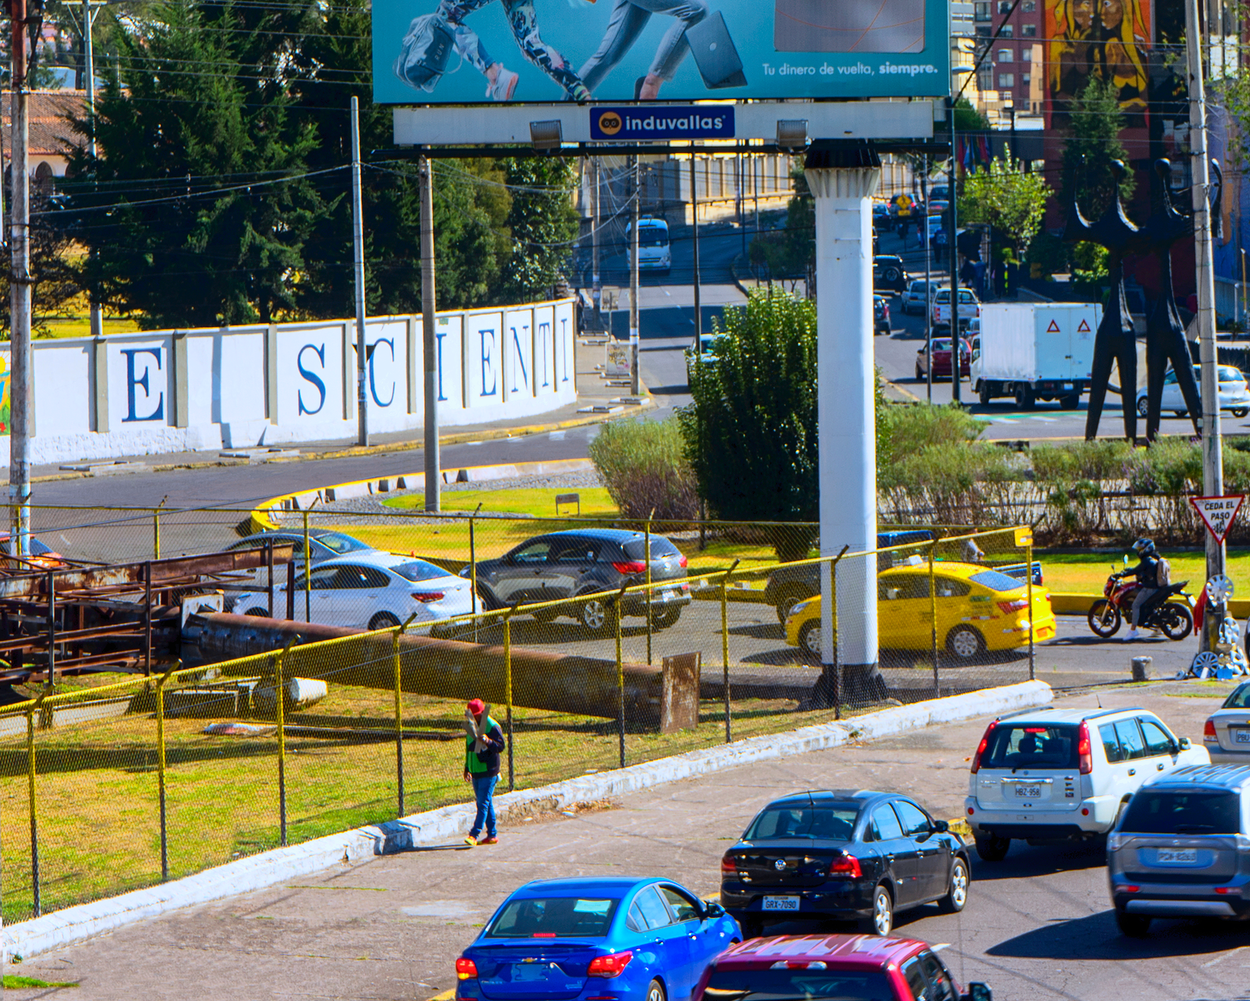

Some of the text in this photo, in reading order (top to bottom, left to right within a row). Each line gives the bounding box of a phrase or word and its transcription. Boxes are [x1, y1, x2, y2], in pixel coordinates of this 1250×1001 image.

[762, 61, 938, 77] Tu dinero de vuelta, siempre.
[625, 115, 723, 131] induvallas
[120, 347, 164, 423] E
[1204, 501, 1234, 510] CEDA EL
[1210, 512, 1230, 520] PASO
[1015, 787, 1040, 796] HBZ-958
[765, 900, 796, 910] GRX-7090
